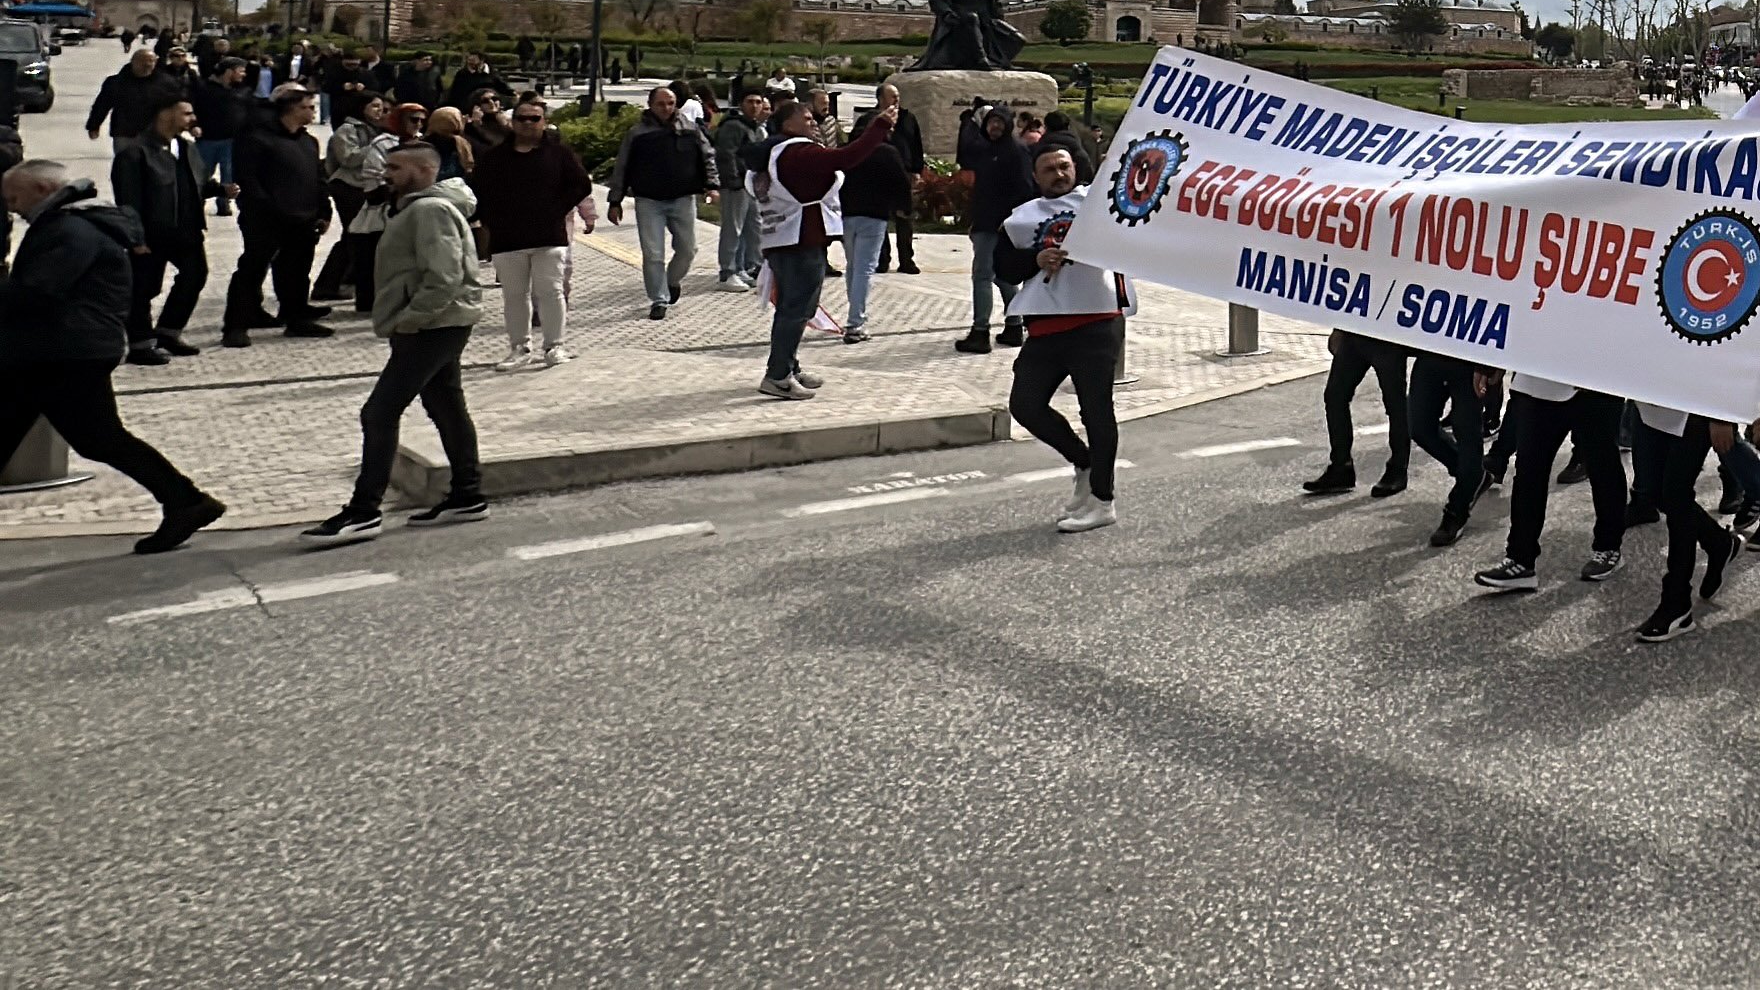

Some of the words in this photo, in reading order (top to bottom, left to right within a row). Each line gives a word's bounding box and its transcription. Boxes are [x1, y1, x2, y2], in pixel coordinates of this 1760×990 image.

[1137, 58, 1286, 142] TÜRKİYE
[1272, 102, 1420, 166] MADEN
[1400, 124, 1582, 181] İŞÇİLERİ
[1176, 160, 1257, 222] EGE
[1237, 166, 1401, 252] BÖLGESİ
[1388, 191, 1415, 258] 1
[1414, 194, 1529, 281] NOLU
[1531, 212, 1656, 310] ŞUBE
[1235, 247, 1371, 318] MANİSA
[1375, 279, 1397, 320] /
[1397, 282, 1511, 350] SOMA
[1678, 307, 1728, 330] 1952
